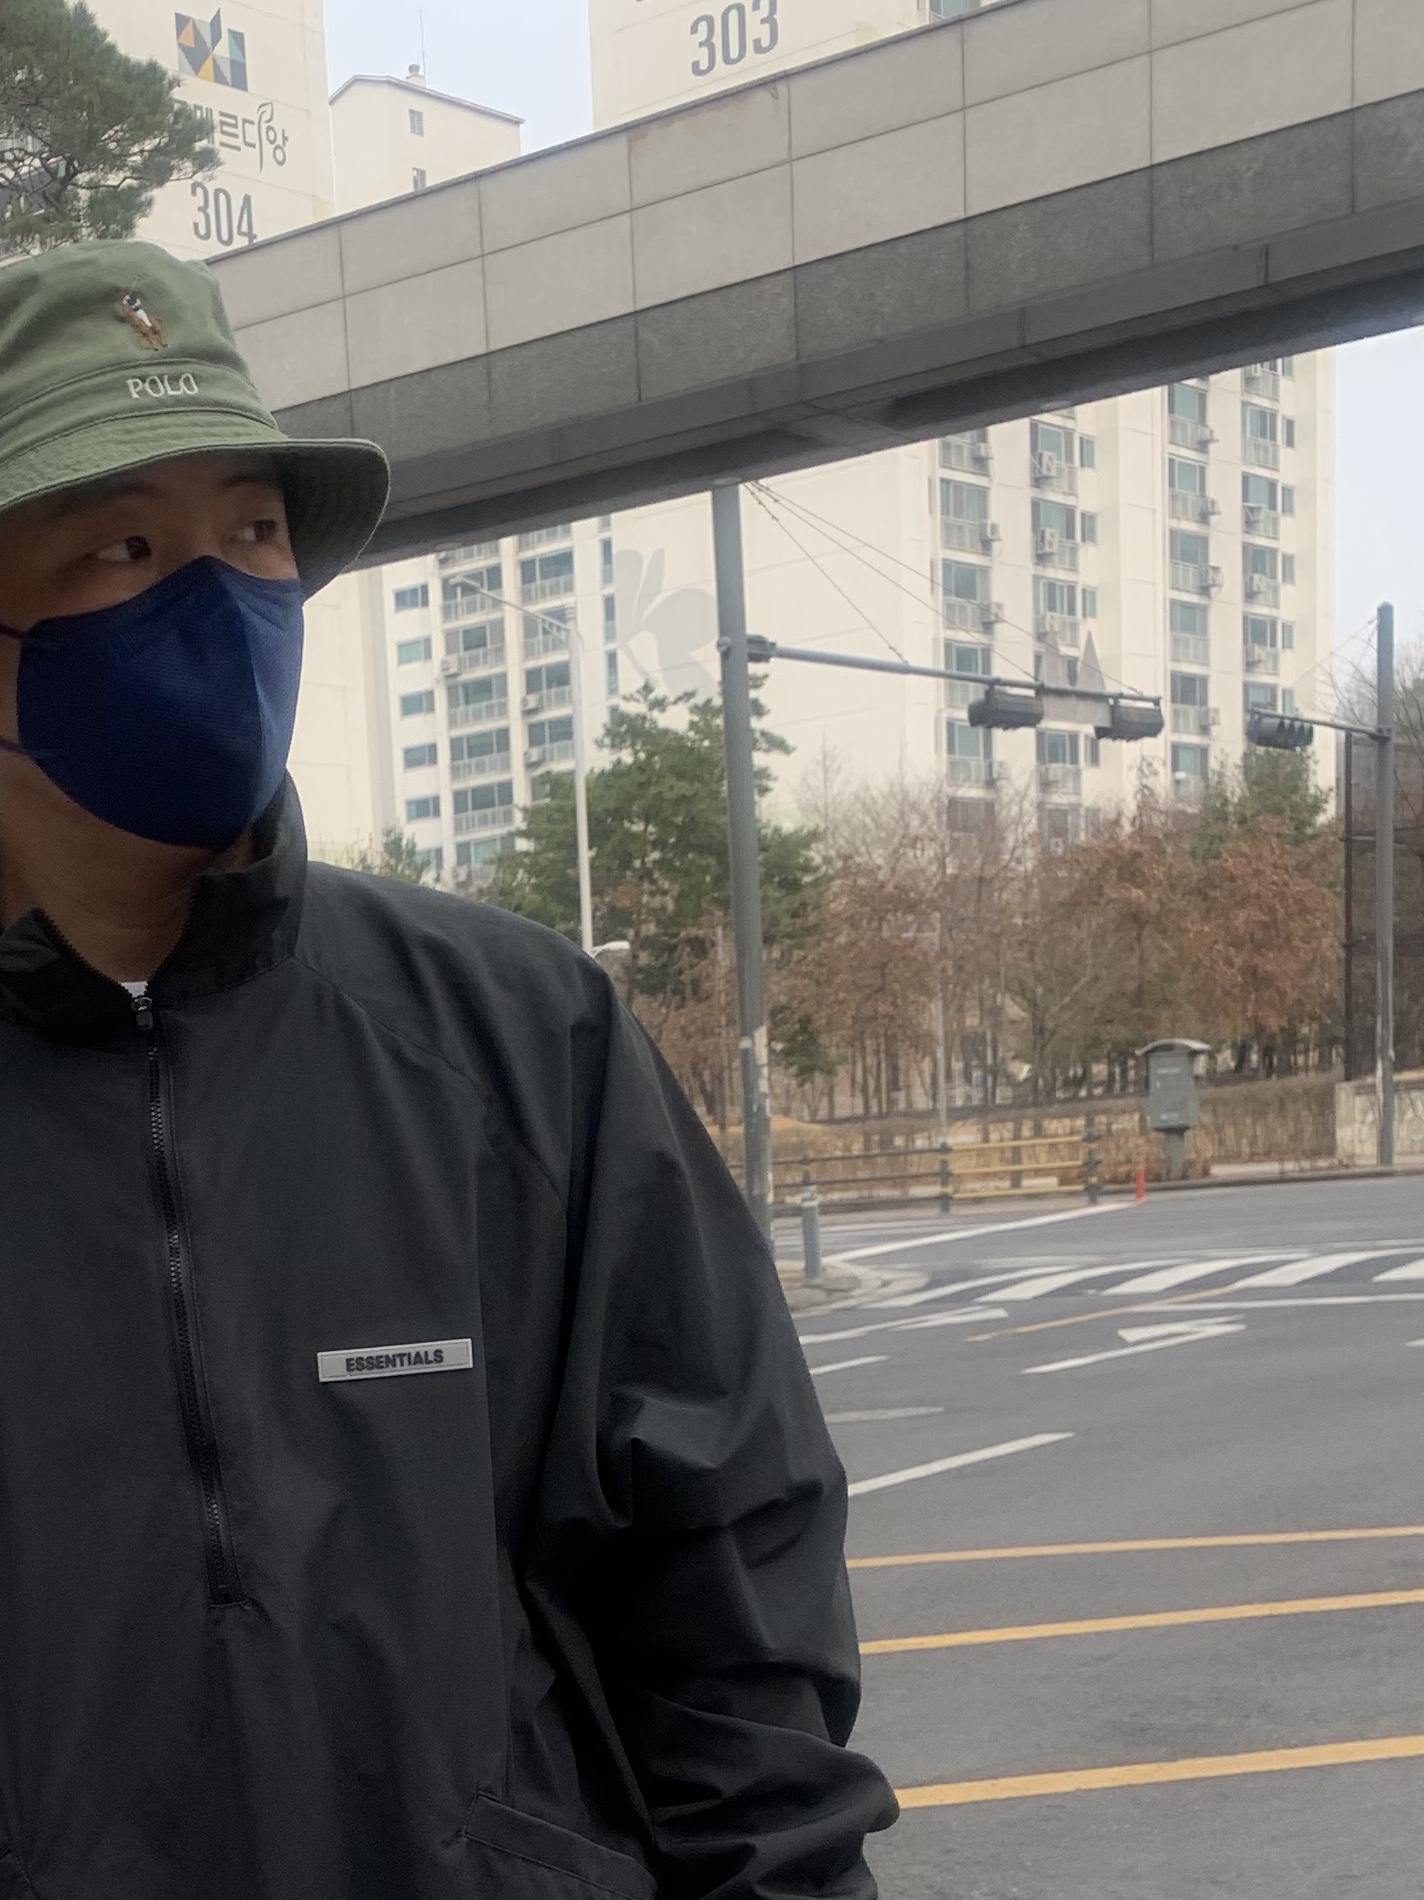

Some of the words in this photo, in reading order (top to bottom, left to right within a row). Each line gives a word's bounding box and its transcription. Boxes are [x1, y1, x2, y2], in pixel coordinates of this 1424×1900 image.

[690, 0, 779, 77] 303
[190, 181, 257, 247] 304
[125, 373, 199, 399] POLO
[345, 1349, 444, 1373] ESSENTIALS
